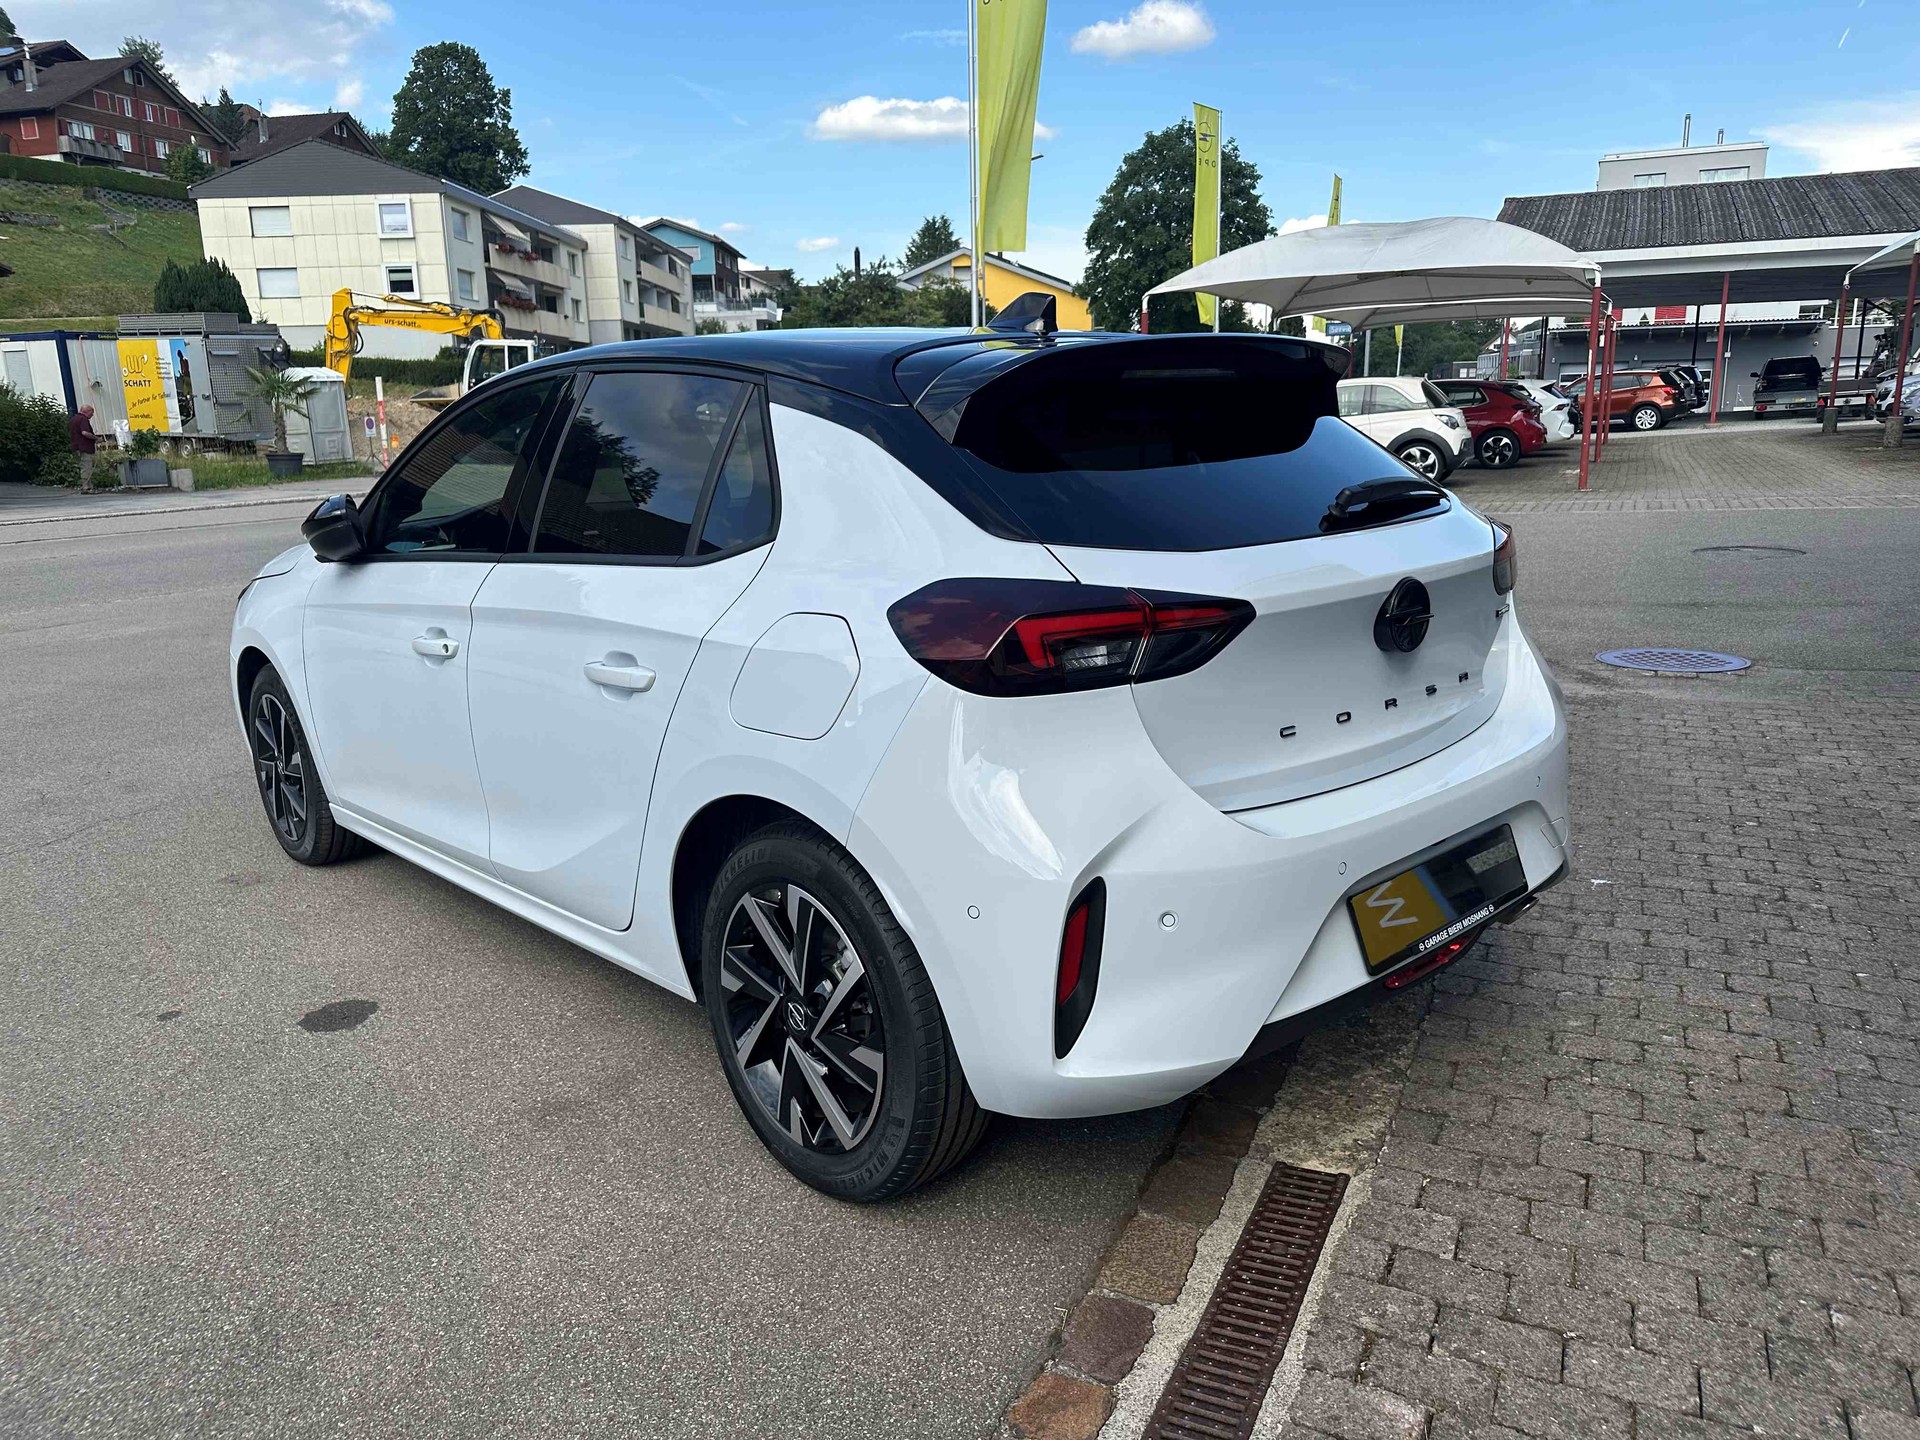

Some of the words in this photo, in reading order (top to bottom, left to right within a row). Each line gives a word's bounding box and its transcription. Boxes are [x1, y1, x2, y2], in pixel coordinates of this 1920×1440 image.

[124, 379, 151, 387] SCHATT
[1279, 671, 1469, 738] CORSA
[1424, 929, 1449, 948] GARAGE
[1447, 921, 1463, 936] BIERI
[1462, 907, 1490, 928] MOSNANG
